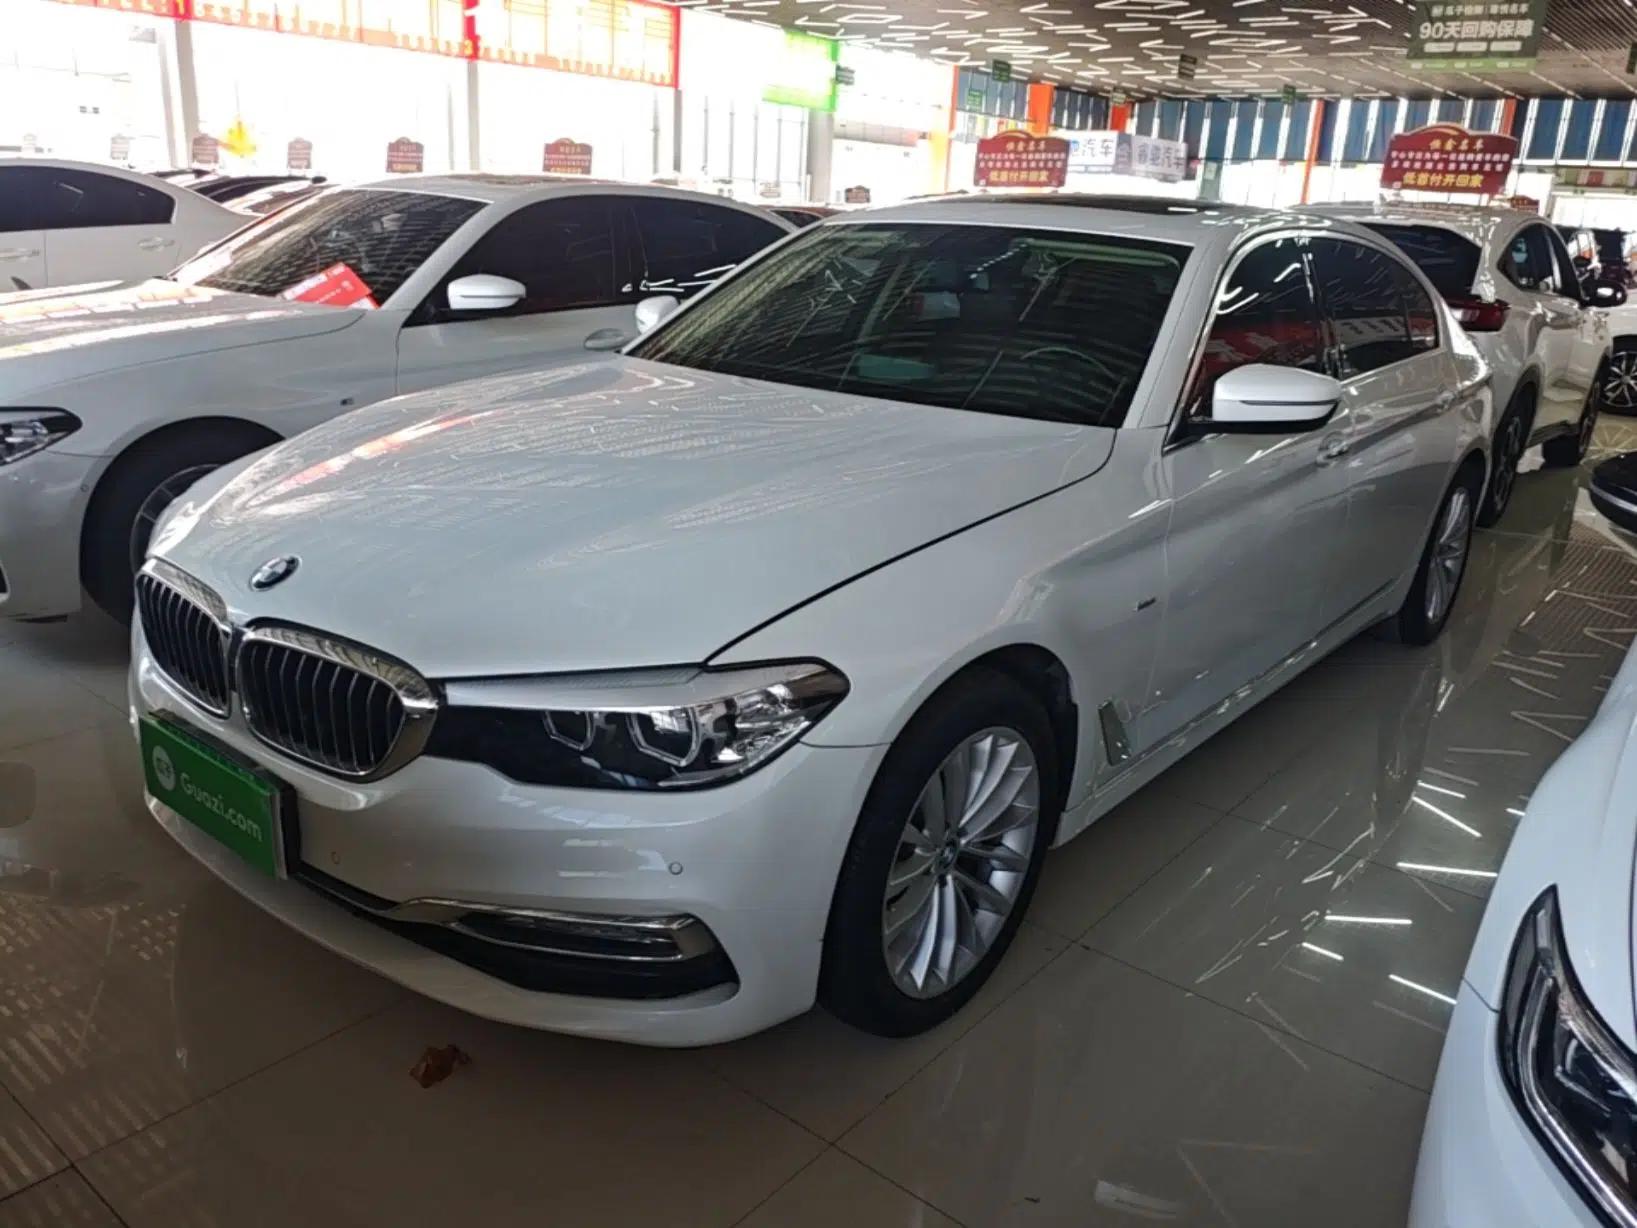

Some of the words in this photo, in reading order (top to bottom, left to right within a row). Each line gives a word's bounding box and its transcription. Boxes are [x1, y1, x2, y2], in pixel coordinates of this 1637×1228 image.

[1419, 19, 1534, 39] 90天回购保障
[1402, 171, 1484, 188] 低首付开回家
[180, 772, 263, 842] Guazi.com
